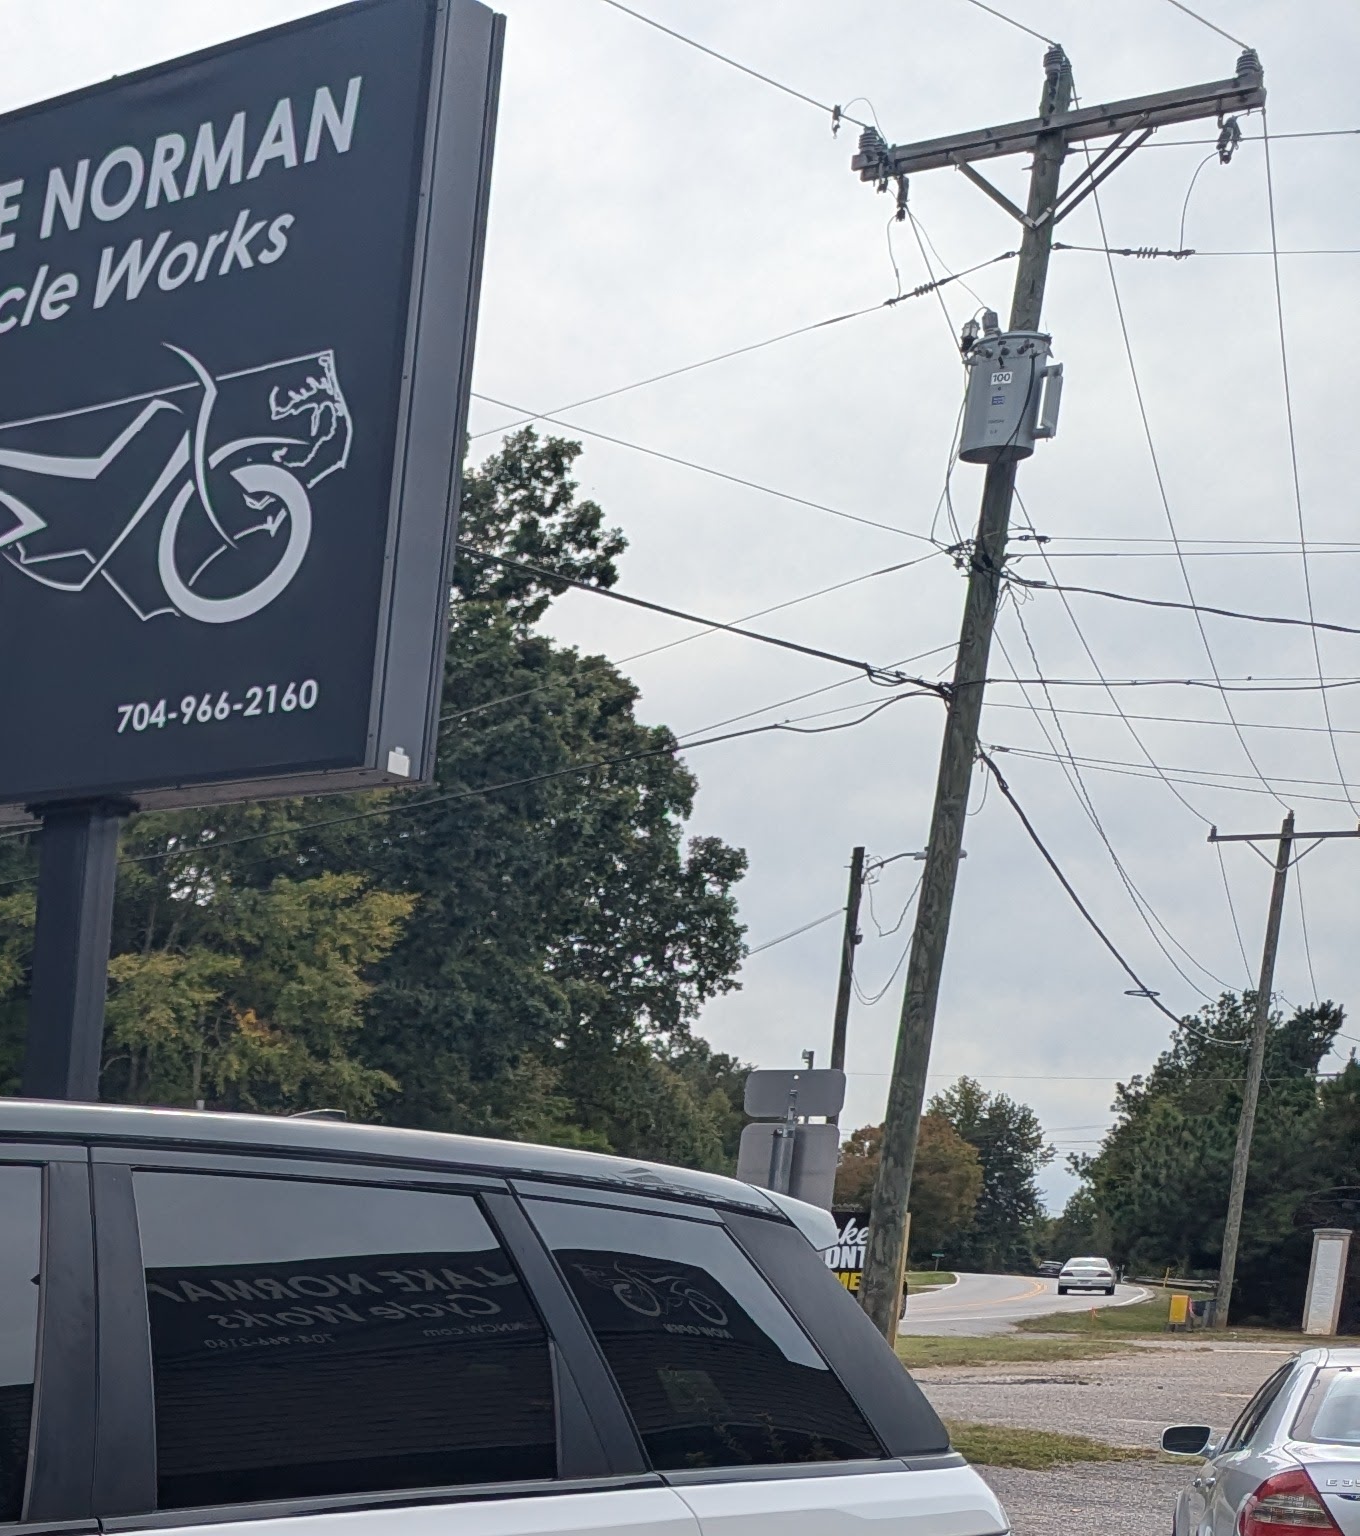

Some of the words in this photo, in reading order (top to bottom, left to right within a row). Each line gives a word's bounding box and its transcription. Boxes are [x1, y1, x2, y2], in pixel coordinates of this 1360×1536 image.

[39, 75, 363, 239] NORMAN
[93, 208, 296, 310] Works
[993, 373, 1011, 383] 100
[117, 679, 319, 734] 704-966-2160
[837, 1217, 870, 1245] ke
[823, 1245, 867, 1269] ONT
